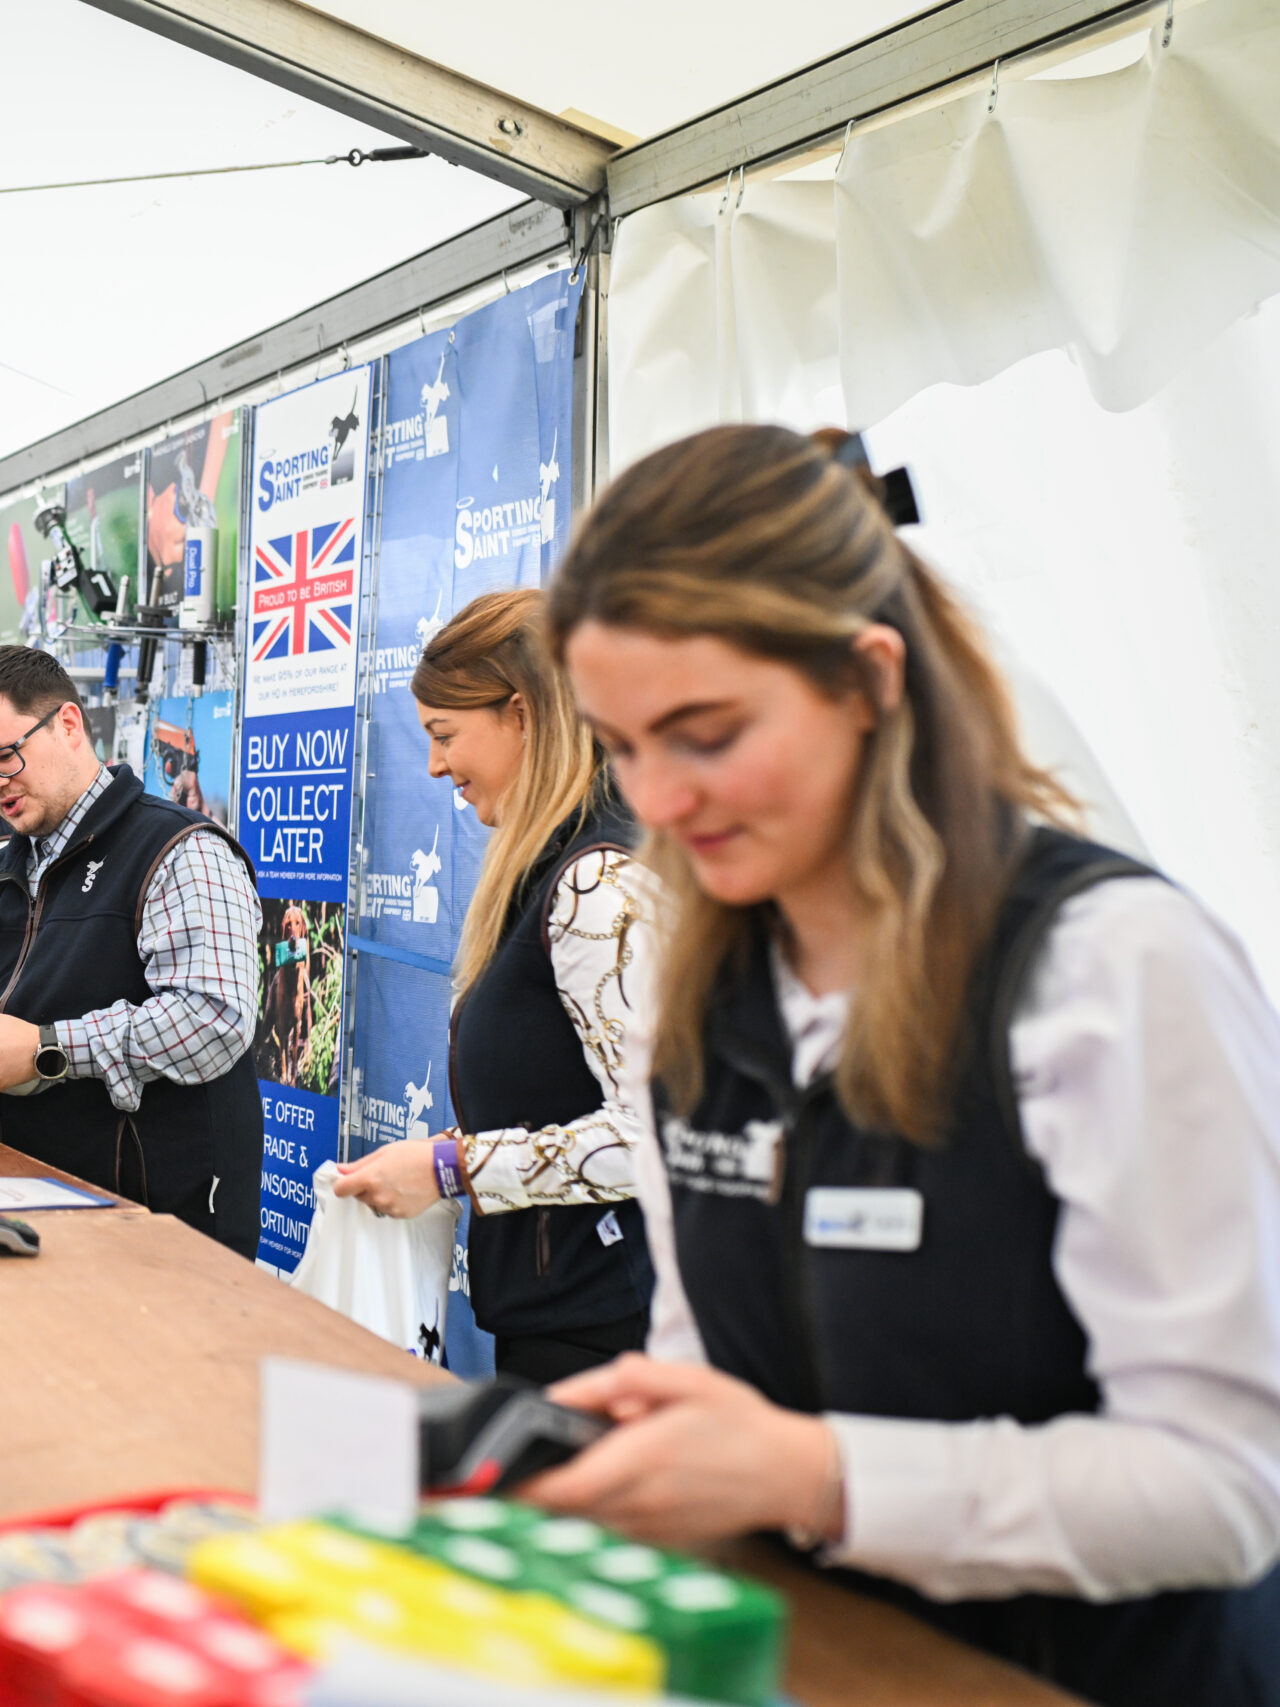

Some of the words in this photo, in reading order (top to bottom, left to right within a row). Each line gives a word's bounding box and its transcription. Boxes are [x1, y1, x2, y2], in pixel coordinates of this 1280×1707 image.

[258, 446, 328, 512] SPORTING
[187, 547, 197, 571] Dual
[187, 571, 197, 589] Pro
[258, 592, 285, 609] PROUD
[287, 590, 297, 602] TO
[300, 587, 310, 599] BE
[313, 579, 347, 597] BRITISH
[248, 733, 289, 770] BUY
[296, 728, 349, 767] NOW
[246, 784, 344, 822] COLLECT
[260, 828, 323, 863] LATER
[305, 872, 316, 881] MORE
[317, 873, 342, 882] INFORMATION
[262, 1097, 272, 1120] E
[276, 1101, 315, 1131] OFFER
[264, 1134, 296, 1164] RADE
[299, 1145, 308, 1168] &
